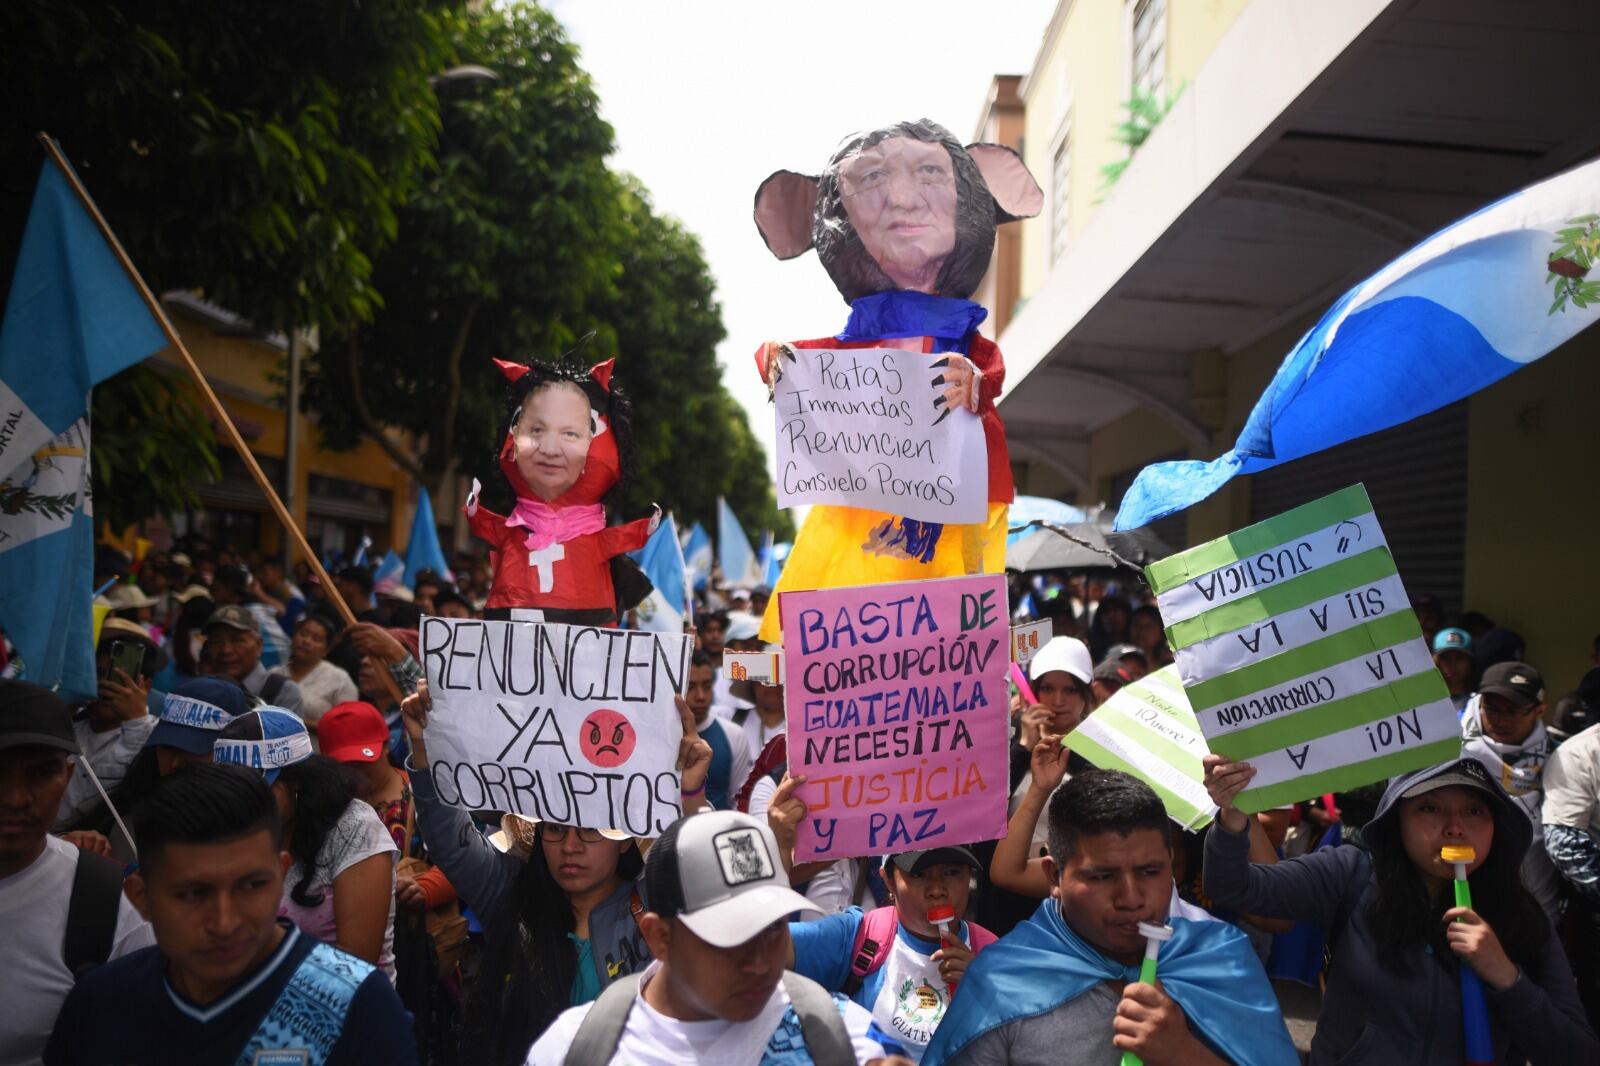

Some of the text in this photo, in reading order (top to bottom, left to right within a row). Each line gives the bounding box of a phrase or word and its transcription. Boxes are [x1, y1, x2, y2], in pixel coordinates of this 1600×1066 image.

[815, 352, 902, 395] Ratas
[787, 389, 913, 426] Inmundas
[784, 460, 867, 495] Consuelo
[1194, 542, 1313, 601] JUSTICIA
[799, 588, 999, 656] BASTA DE
[1238, 620, 1284, 653] LA
[1309, 604, 1328, 632] A
[423, 618, 688, 703] RENUNCIEN
[804, 681, 989, 732] GUATEMALA
[1217, 649, 1403, 727] LA CORRUPCIÓN
[496, 703, 573, 766] YA
[1286, 745, 1310, 770] A
[432, 760, 682, 836] CORRUPTOS
[868, 808, 945, 848] PAZ
